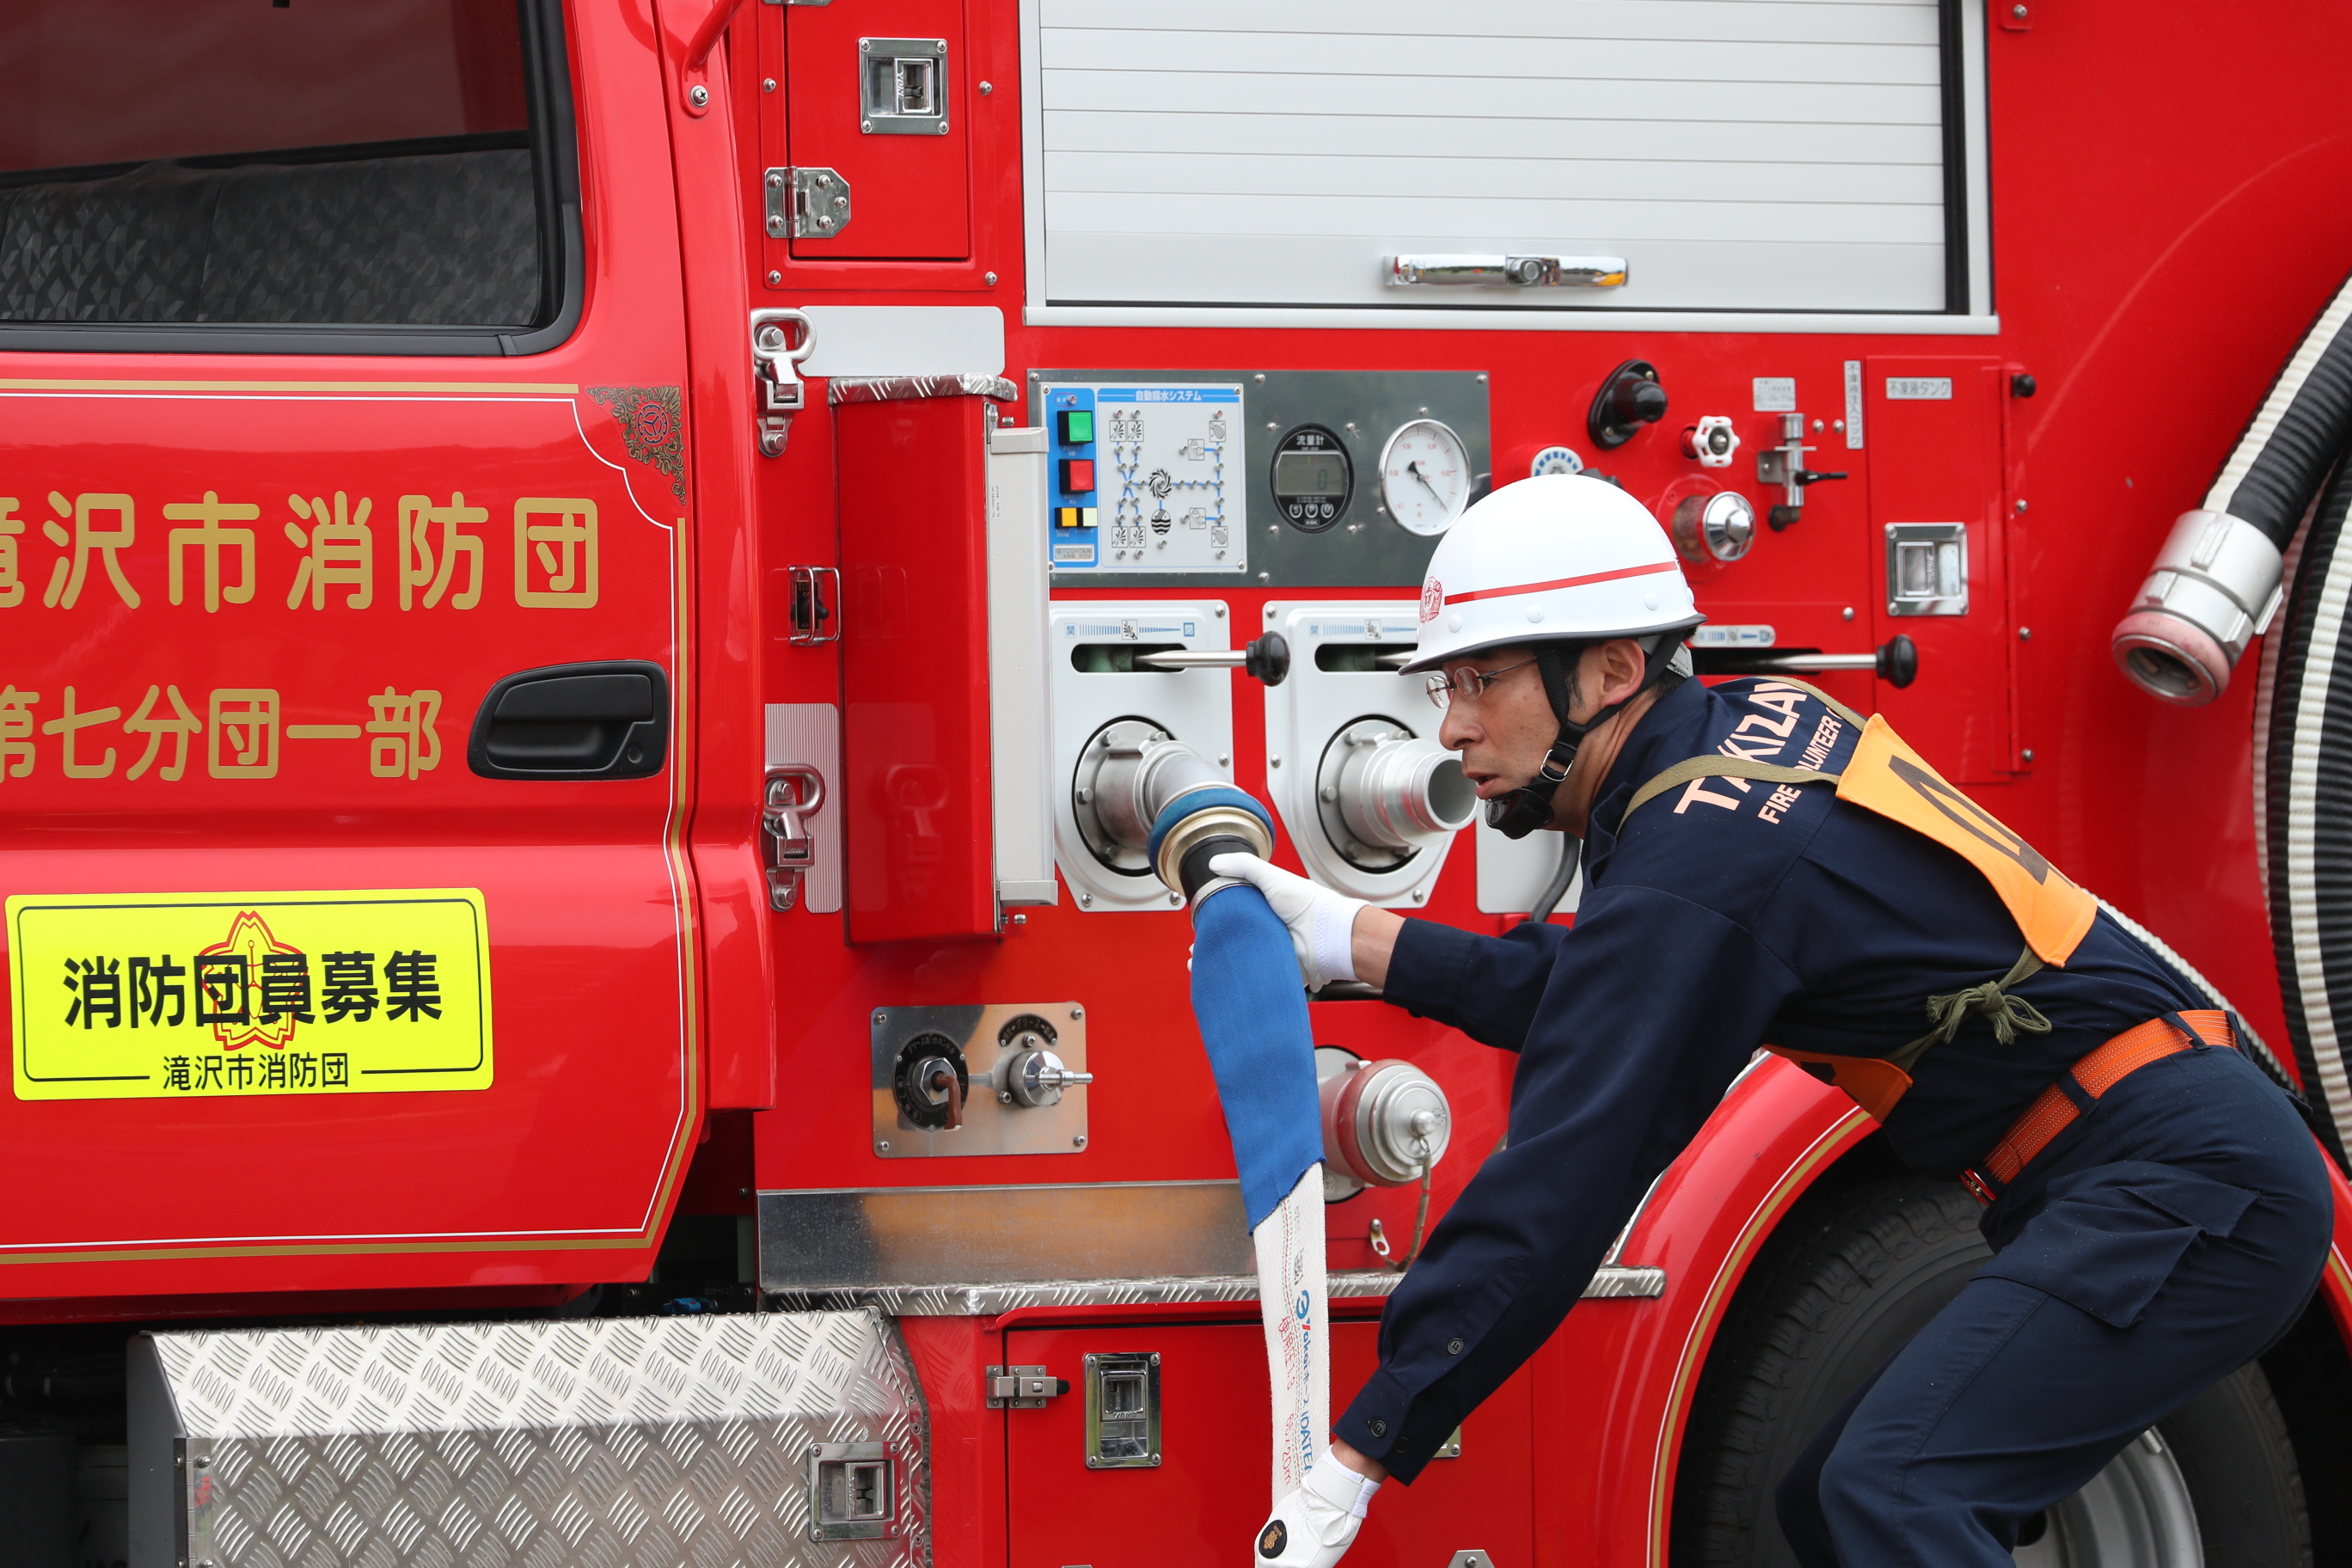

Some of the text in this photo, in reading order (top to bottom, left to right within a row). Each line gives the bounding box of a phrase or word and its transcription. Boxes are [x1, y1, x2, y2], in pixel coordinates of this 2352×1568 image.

[1889, 380, 1951, 396] 不凍液タンク
[1296, 435, 1325, 445] 流量計
[0, 491, 599, 613] 沢市消防団
[1757, 784, 1803, 824] FIRE
[63, 950, 444, 1029] 消防団員募集
[162, 1052, 349, 1091] 滝沢市消防団
